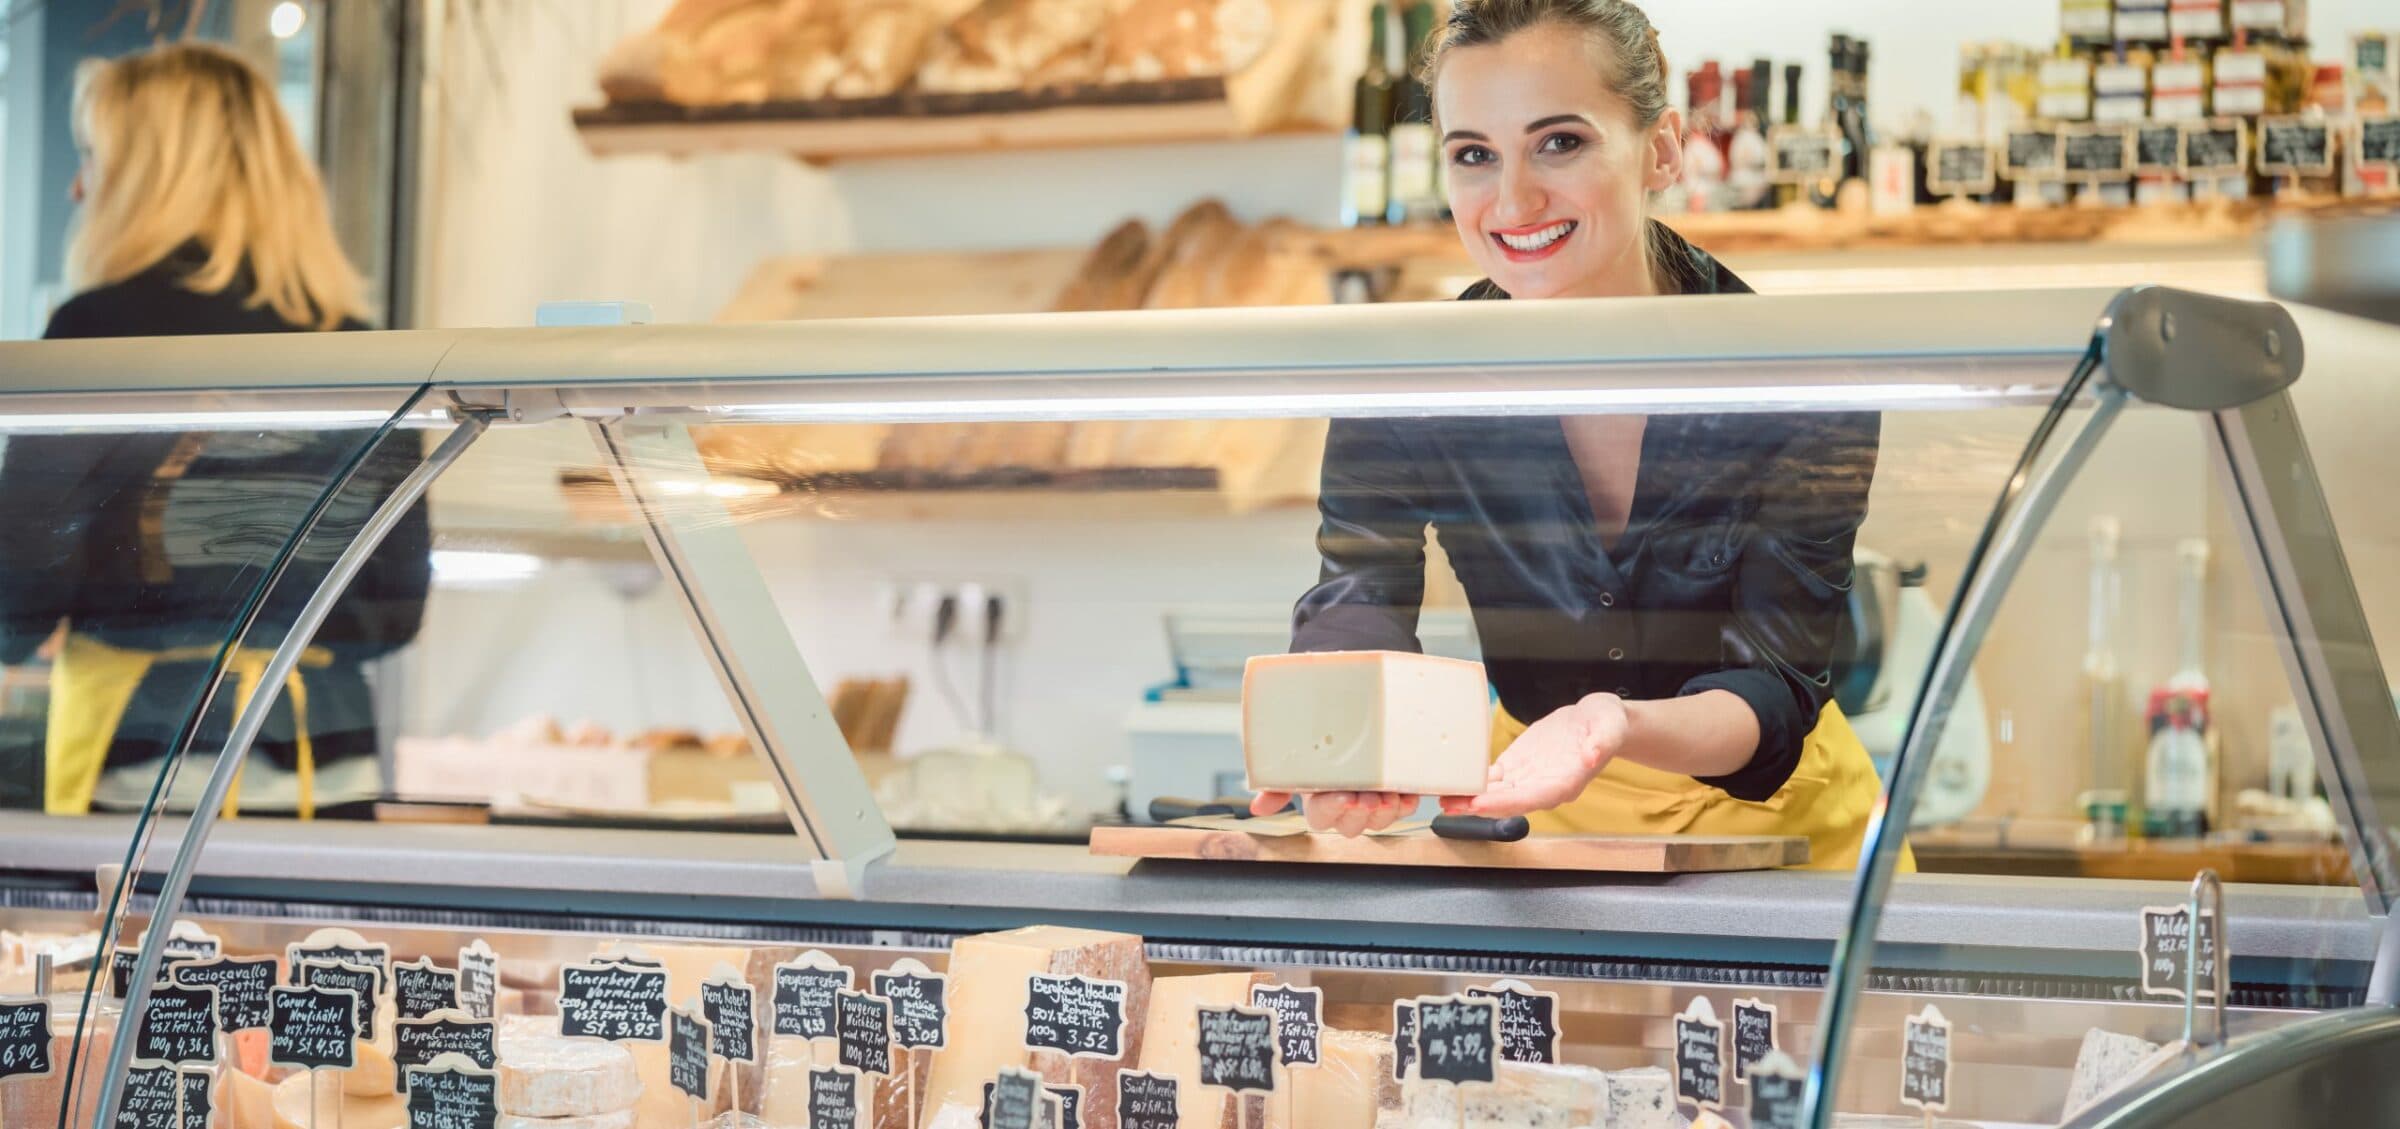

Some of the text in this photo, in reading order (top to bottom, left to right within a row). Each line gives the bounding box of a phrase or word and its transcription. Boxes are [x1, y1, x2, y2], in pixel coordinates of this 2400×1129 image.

[179, 963, 269, 983] Caciocavallo
[567, 970, 664, 990] Camembert de
[217, 979, 266, 994] Grotta
[585, 986, 664, 1001] Normandie
[884, 977, 924, 1000] Comté
[1032, 977, 1084, 1004] Bergkäse
[276, 992, 318, 1010] Coeur d.
[405, 999, 420, 1011] 50%
[723, 987, 749, 1008] Robert
[842, 996, 882, 1019] Fougerus
[13, 1006, 40, 1026] foin
[150, 1002, 210, 1022] Camembert
[571, 1009, 600, 1022] 45%
[599, 1010, 630, 1021] Fett
[641, 1011, 657, 1023] Tr.
[1031, 1006, 1056, 1022] 50%
[1056, 1011, 1081, 1026] Fett
[1278, 1008, 1309, 1023] Extra
[150, 1020, 171, 1034] 45%
[172, 1020, 191, 1034] Fett
[196, 1019, 208, 1034] Tr.
[284, 1023, 304, 1037] 45%
[305, 1023, 326, 1036] Fett
[431, 1025, 493, 1042] Camembert
[582, 1019, 610, 1035] St.
[615, 1020, 661, 1037] 9,95
[779, 1015, 801, 1035] 100g
[1285, 1022, 1302, 1037] Fett
[150, 1035, 172, 1058] 100g
[176, 1035, 202, 1057] 4,36
[1029, 1023, 1110, 1050] 100g 3,52
[3, 1043, 37, 1068] 6,90
[297, 1037, 313, 1056] St.
[316, 1037, 346, 1059] 4,56
[728, 1038, 749, 1058] 3,39
[846, 1043, 864, 1066] 100g
[1286, 1038, 1310, 1061] 5,10
[1513, 1047, 1544, 1063] 4,10
[127, 1070, 154, 1086] ont
[410, 1072, 491, 1092] Brie de Meaux
[127, 1097, 150, 1111] 50%
[145, 1112, 166, 1129] St.
[414, 1109, 433, 1129] 45%
